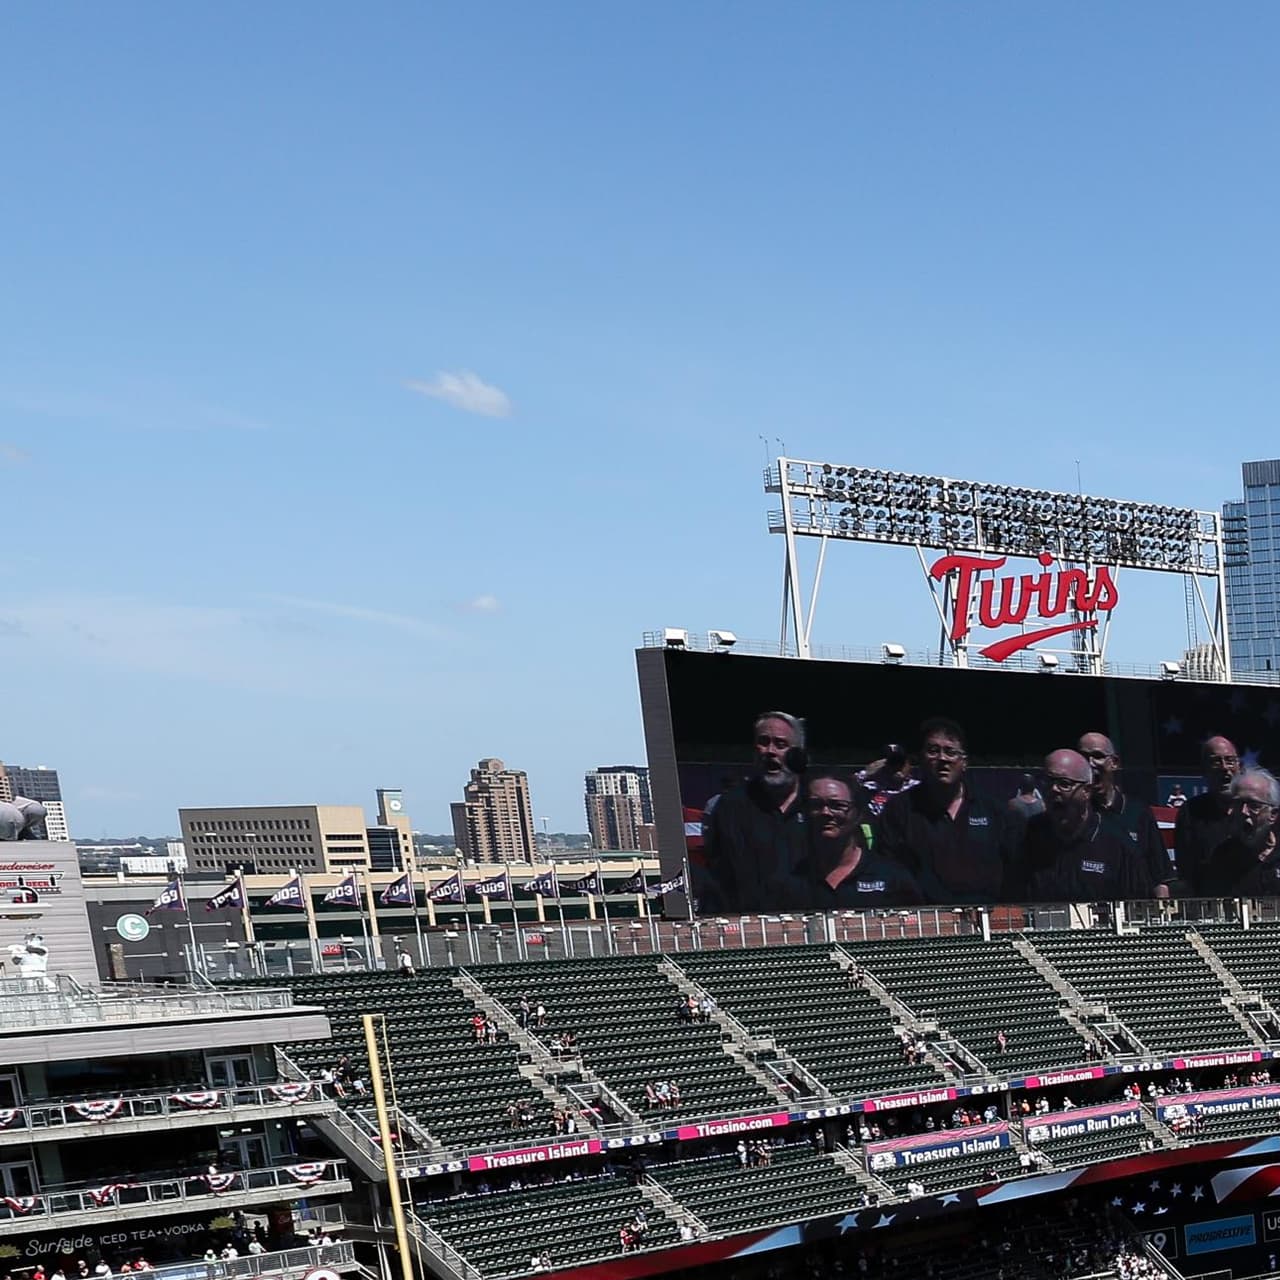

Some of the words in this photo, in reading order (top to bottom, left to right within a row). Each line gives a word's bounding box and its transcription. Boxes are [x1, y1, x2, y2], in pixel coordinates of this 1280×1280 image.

[930, 552, 1118, 641] Twins
[0, 861, 55, 872] udweiser
[1183, 1055, 1224, 1069] Treasure
[1225, 1052, 1254, 1066] Island
[873, 1095, 918, 1111] Treasure
[918, 1090, 949, 1106] Island
[1194, 1098, 1250, 1116] Treasure
[1051, 1121, 1086, 1140] Home
[1087, 1117, 1109, 1134] Run
[1110, 1112, 1138, 1129] Deck
[483, 1148, 546, 1170] Treasure
[548, 1142, 589, 1161] Island
[902, 1145, 960, 1166] Treasure
[961, 1136, 1000, 1159] Island
[25, 1234, 94, 1257] Surfside
[100, 1232, 128, 1246] ICED
[1189, 1224, 1252, 1244] PROGRESSIVE
